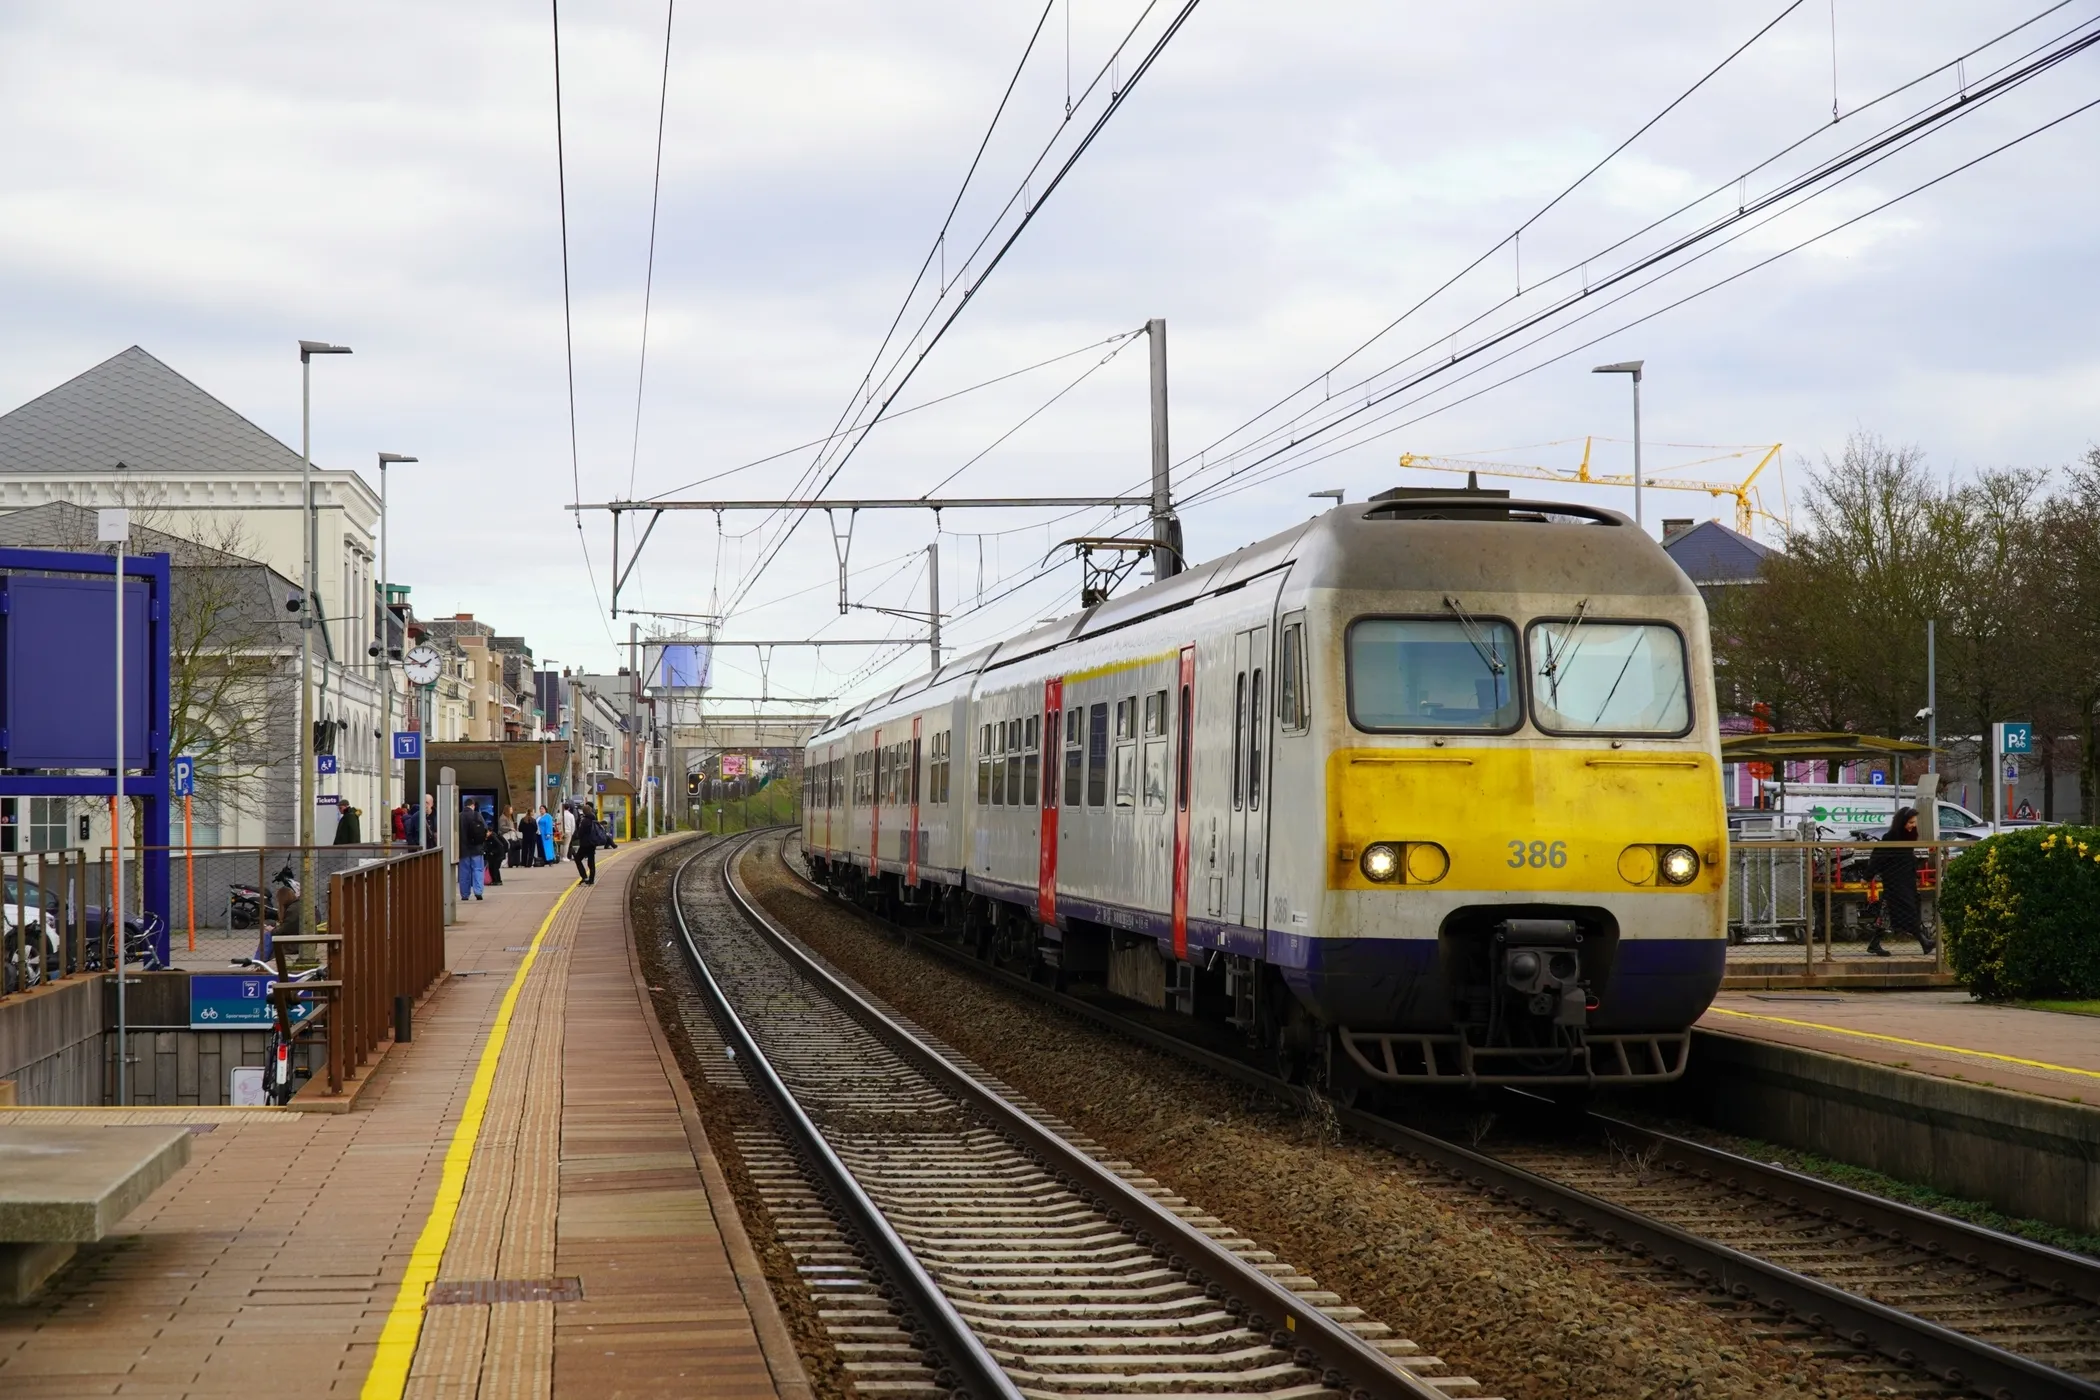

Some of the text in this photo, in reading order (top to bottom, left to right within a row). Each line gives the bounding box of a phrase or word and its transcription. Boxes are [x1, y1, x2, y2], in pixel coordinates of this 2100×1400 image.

[2008, 733, 2018, 748] P
[2019, 729, 2026, 740] 2
[404, 743, 409, 753] 1
[177, 763, 190, 790] P
[1873, 773, 1882, 785] P
[1507, 840, 1567, 869] 386
[1273, 896, 1287, 924] 386
[248, 987, 254, 996] 2
